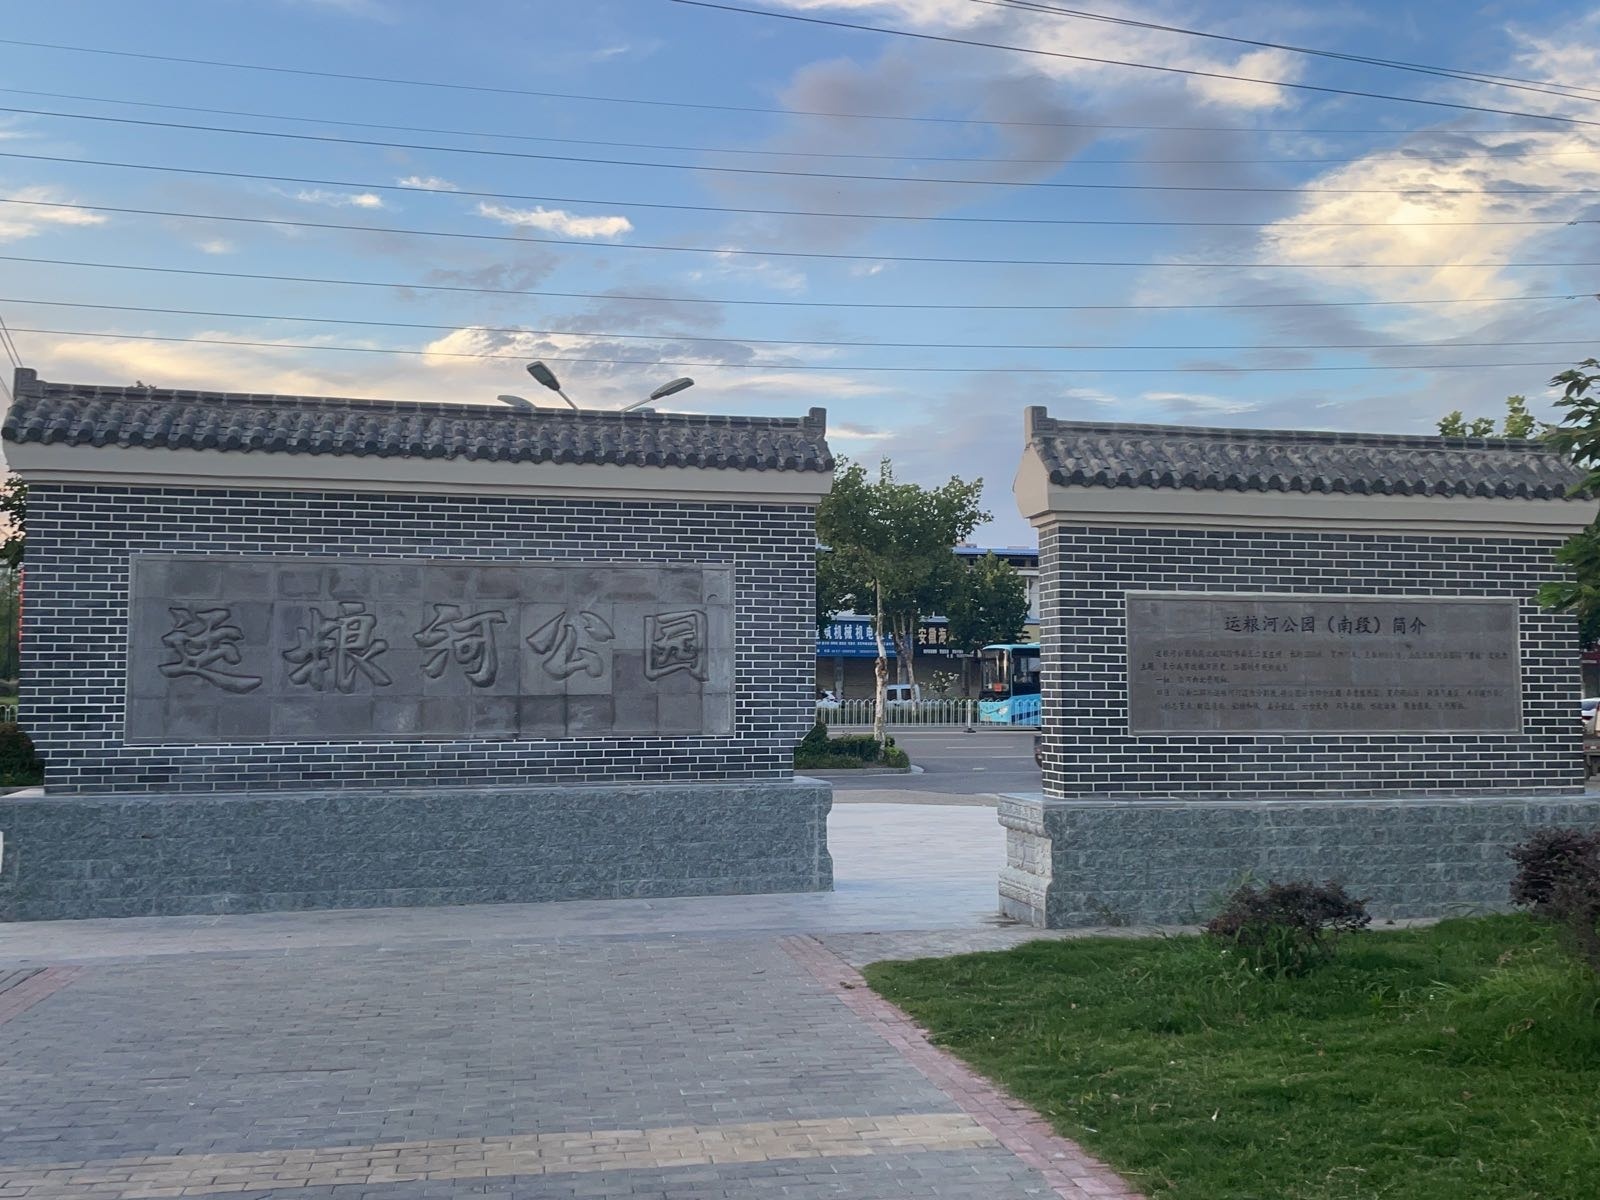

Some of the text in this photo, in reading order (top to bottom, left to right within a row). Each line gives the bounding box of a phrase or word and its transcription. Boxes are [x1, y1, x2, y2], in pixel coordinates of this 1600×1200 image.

[158, 602, 710, 694] 运粮河公园
